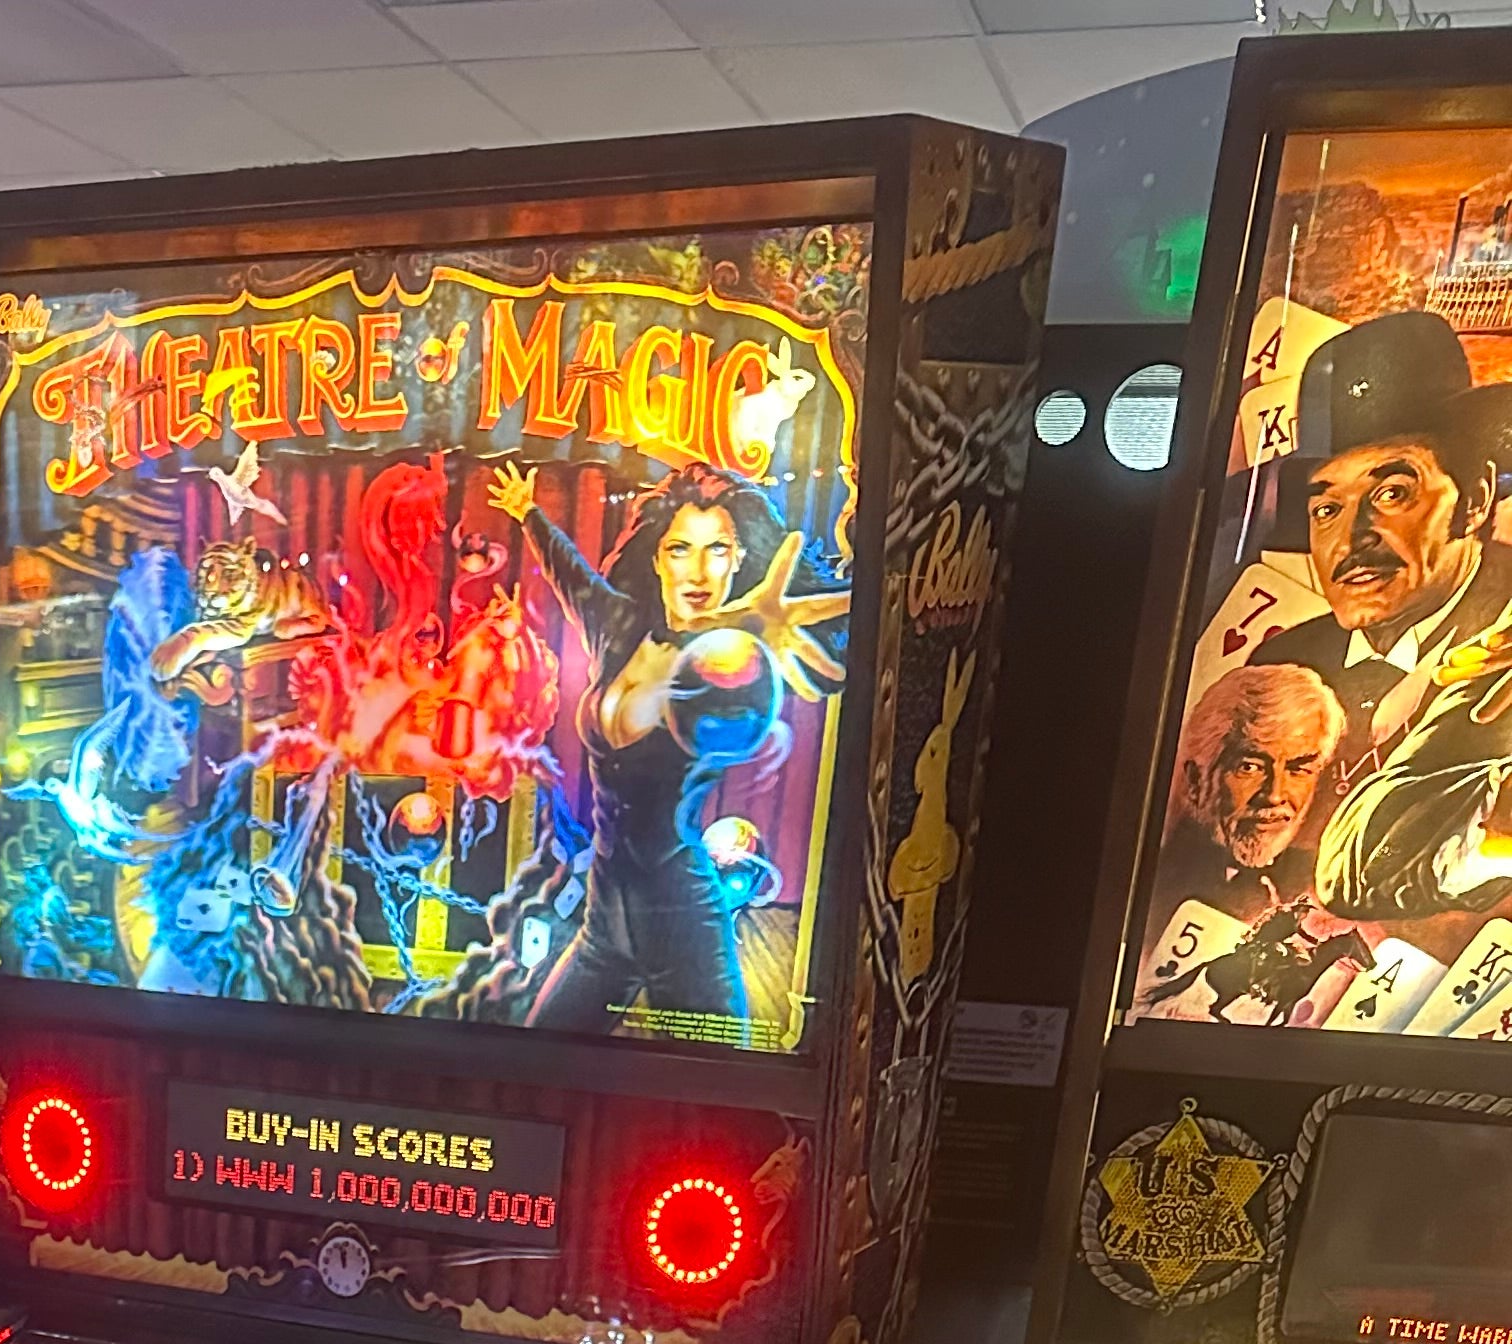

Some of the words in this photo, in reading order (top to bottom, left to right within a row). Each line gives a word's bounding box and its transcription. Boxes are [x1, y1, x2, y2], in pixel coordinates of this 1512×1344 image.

[32, 310, 410, 498] THEATRE
[416, 322, 470, 386] of
[474, 297, 778, 478] MAGIC
[1257, 404, 1290, 450] K
[1238, 586, 1279, 630] 7
[1171, 921, 1205, 959] 5
[1370, 957, 1405, 995] A
[1469, 941, 1510, 983] K
[224, 1107, 343, 1158] BUY-IN
[352, 1123, 496, 1174] SCORES
[171, 1149, 206, 1187] 1)
[215, 1156, 297, 1197] WWW
[308, 1166, 558, 1232] 1,000,000,000
[1101, 1218, 1258, 1259] MARSHAL
[1359, 1315, 1375, 1335] A
[1389, 1317, 1450, 1341] TIME
